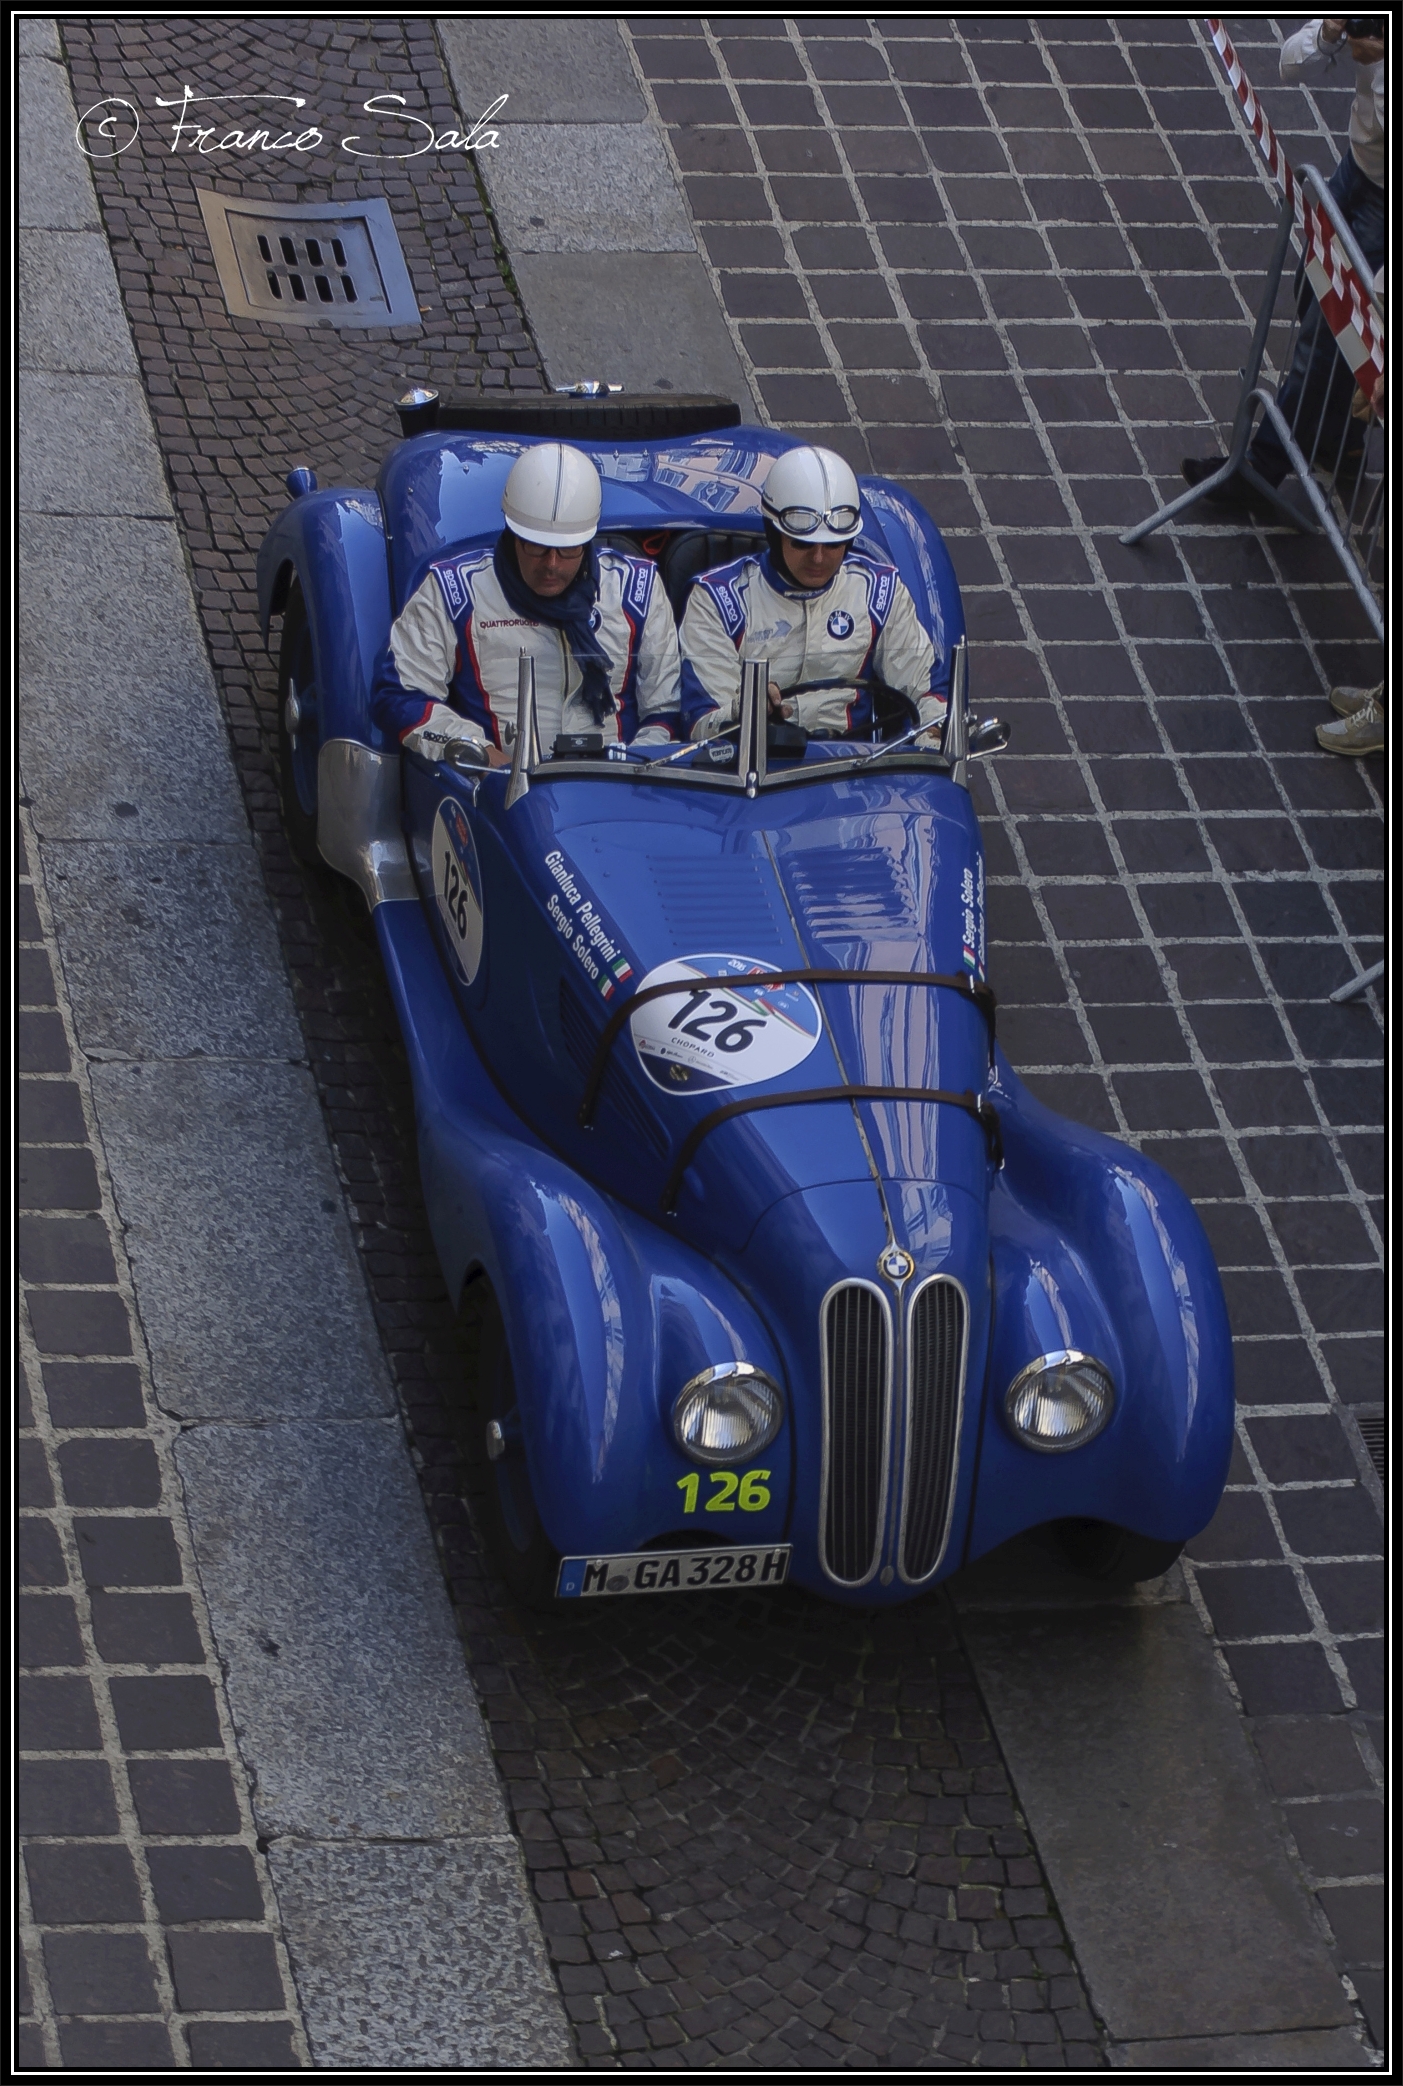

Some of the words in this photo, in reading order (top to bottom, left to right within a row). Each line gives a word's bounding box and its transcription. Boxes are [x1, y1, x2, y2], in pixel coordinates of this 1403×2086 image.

[443, 568, 462, 605] sparco
[634, 567, 648, 603] sparco
[716, 585, 738, 622] sparco
[875, 575, 890, 612] sparco
[421, 730, 452, 744] sparc
[443, 850, 468, 940] 126
[544, 850, 582, 906] Gianluca
[576, 901, 621, 963] Pellegrini
[960, 867, 974, 908] Solero
[546, 894, 574, 939] Sergio
[572, 934, 600, 980] Solero
[962, 908, 977, 949] Sergio
[667, 987, 768, 1054] 126
[671, 1037, 715, 1058] CHOPARD
[676, 1469, 772, 1514] 126
[565, 1582, 575, 1591] D
[581, 1563, 609, 1592] M
